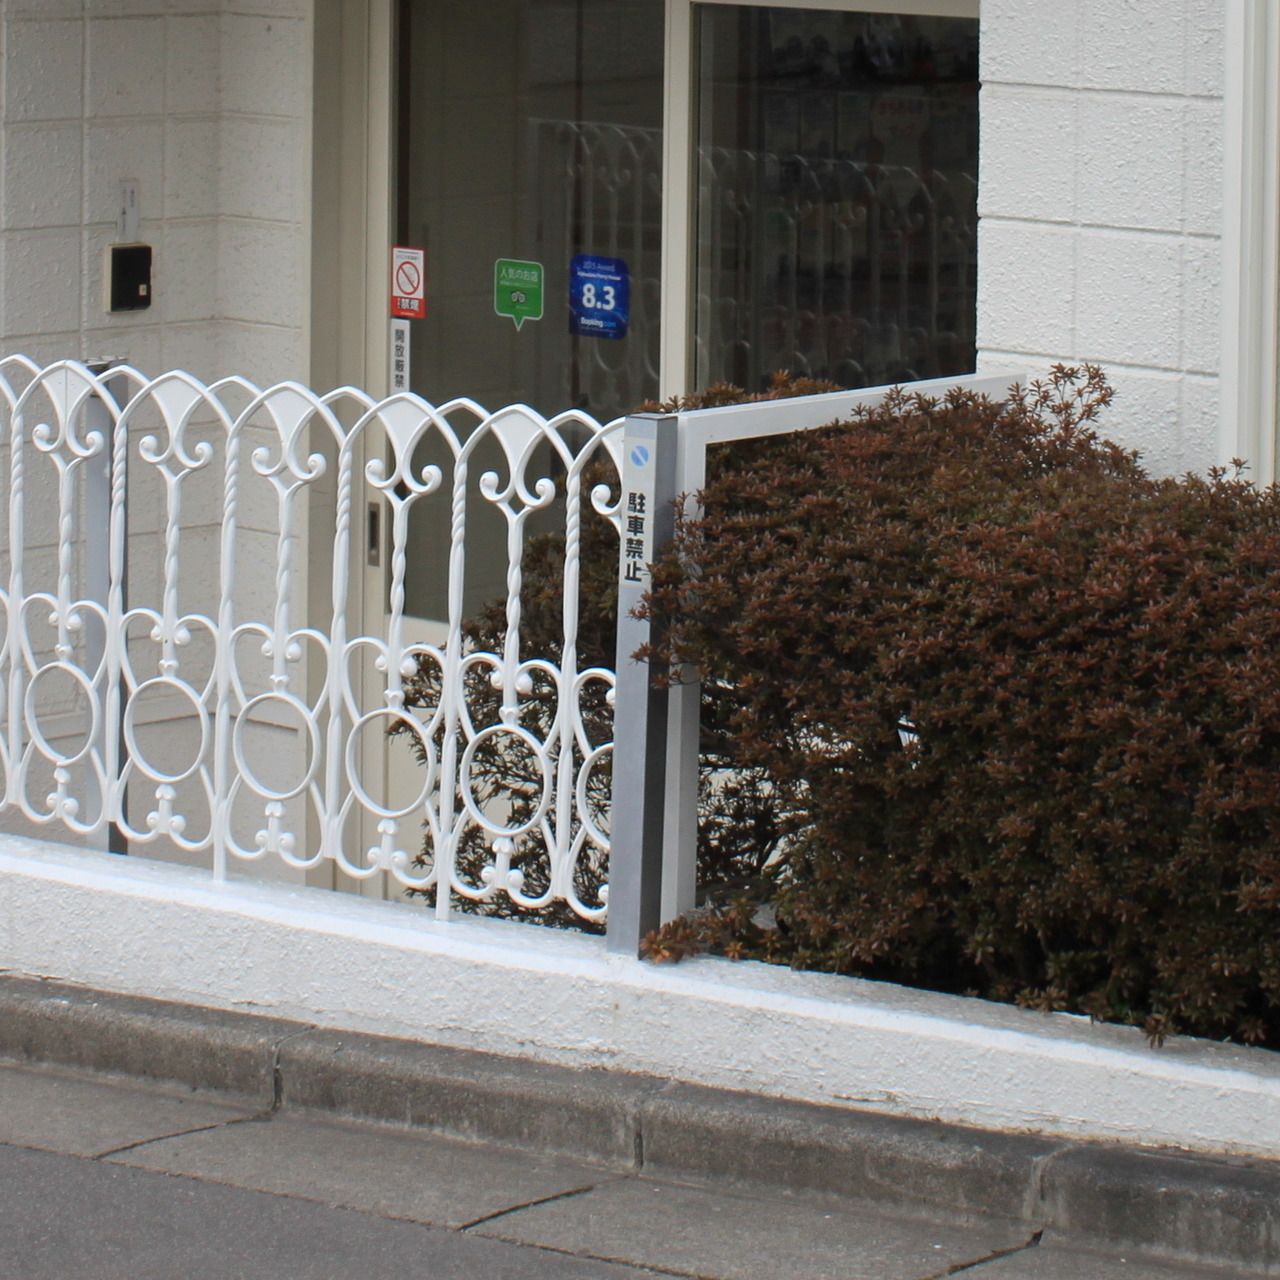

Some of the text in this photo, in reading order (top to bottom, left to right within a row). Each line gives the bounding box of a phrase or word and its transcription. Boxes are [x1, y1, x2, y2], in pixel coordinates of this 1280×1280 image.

[582, 283, 616, 311] 8.3
[624, 492, 646, 582] 駐車禁止
